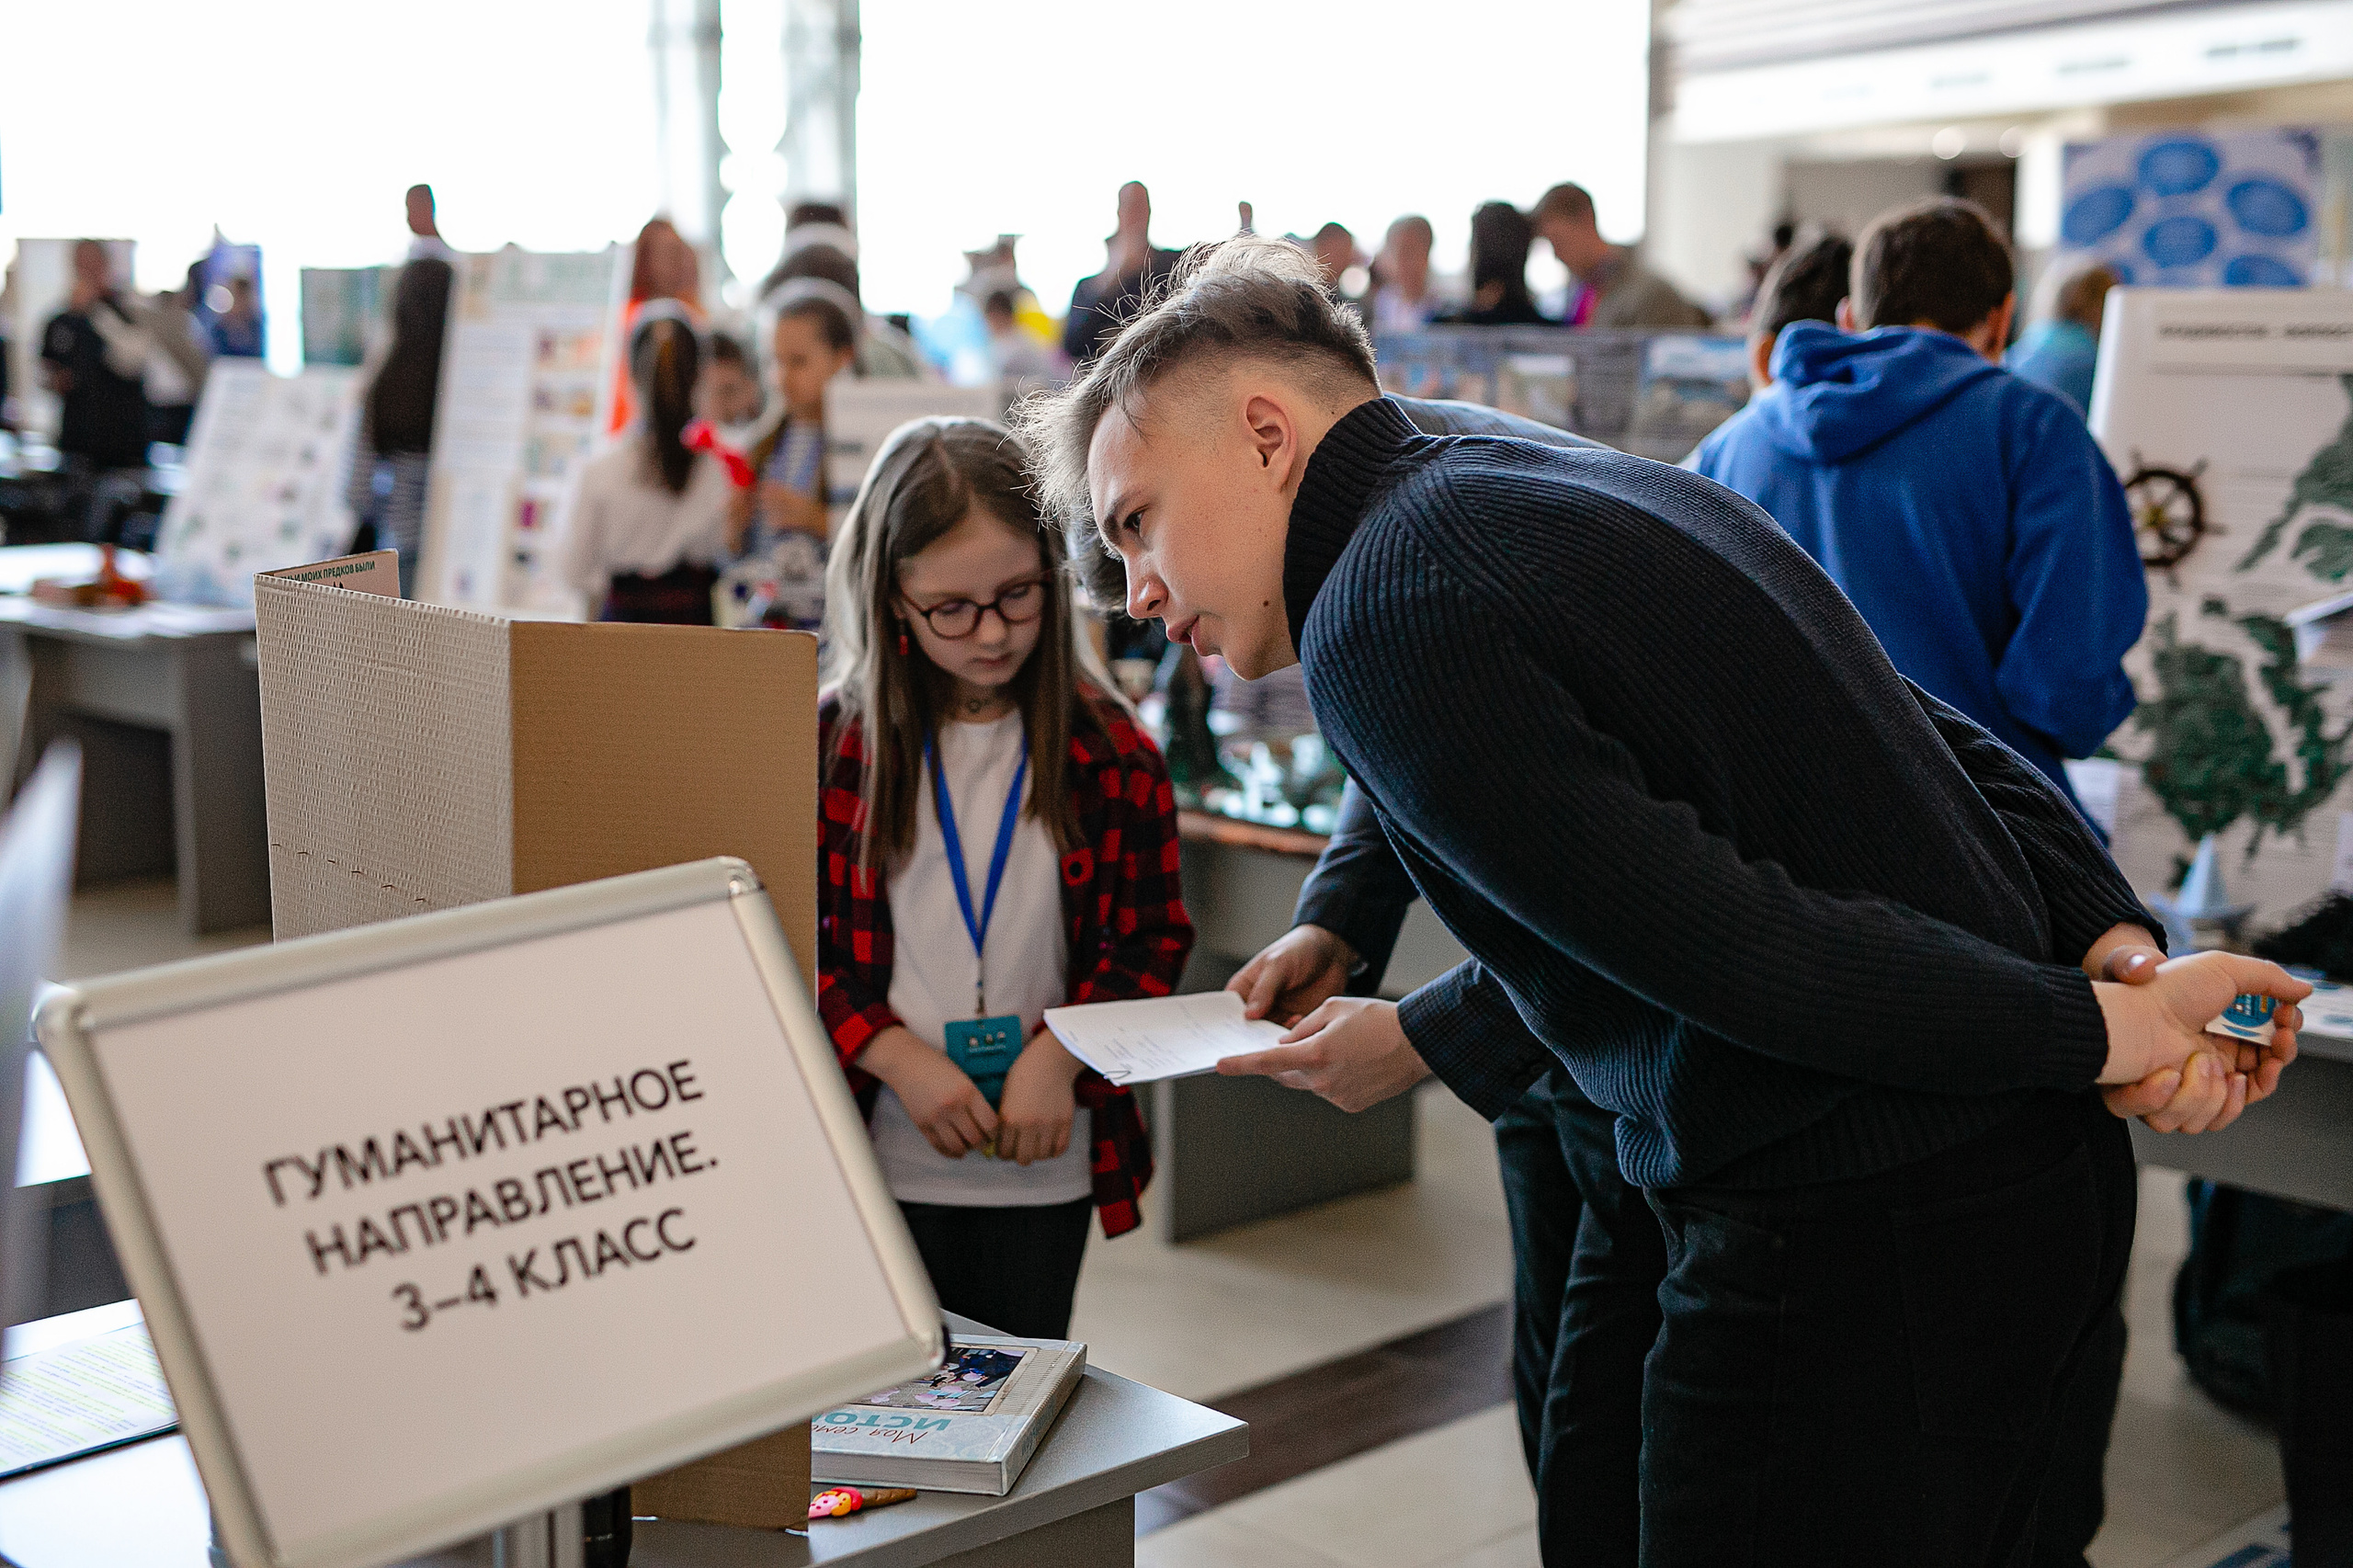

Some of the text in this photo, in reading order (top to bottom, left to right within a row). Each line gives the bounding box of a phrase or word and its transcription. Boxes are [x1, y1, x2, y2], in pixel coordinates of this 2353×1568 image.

[301, 569, 323, 582] МОИХ
[324, 563, 354, 578] ПРЕДКОВ
[355, 561, 375, 573] БЫЛИ
[263, 1060, 704, 1206] ГУМАНИТАРНОЕ
[304, 1131, 719, 1276] НАПРАВЛЕНИЕ.
[506, 1208, 698, 1297] КЛАСС
[812, 1412, 951, 1431] ИСТО
[869, 1428, 928, 1445] Моя
